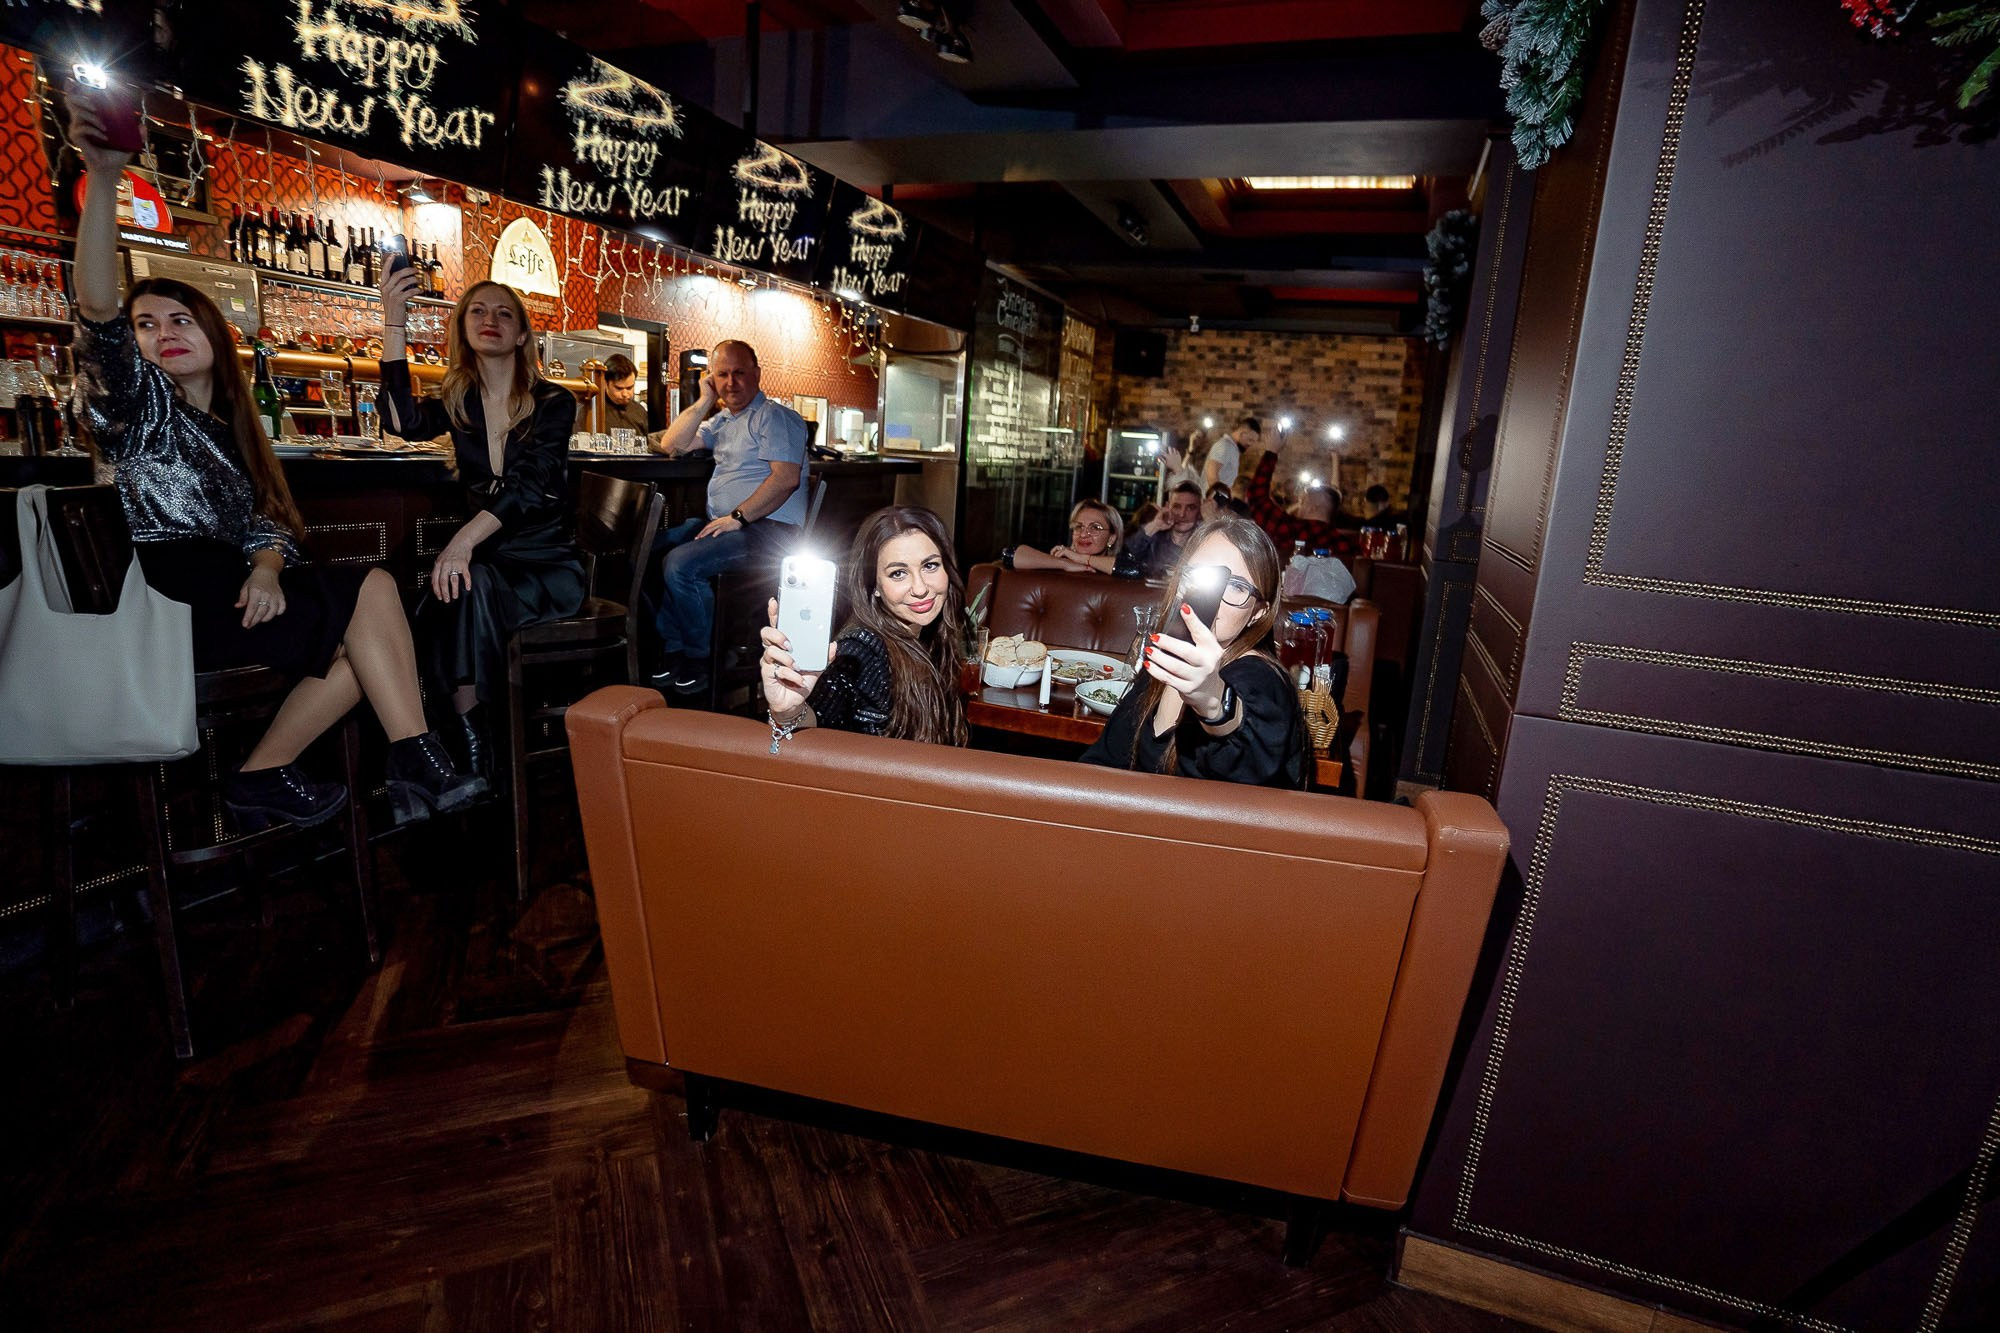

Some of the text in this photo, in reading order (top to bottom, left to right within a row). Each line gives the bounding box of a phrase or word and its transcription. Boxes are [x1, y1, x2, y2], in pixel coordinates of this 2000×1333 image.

[297, 0, 440, 91] Happy
[241, 60, 495, 148] New Year
[574, 119, 659, 179] Happy
[540, 165, 690, 218] New Year
[738, 187, 797, 234] Happy
[508, 243, 545, 275] Leffe
[713, 226, 815, 264] New Year
[851, 235, 893, 271] Happy
[832, 266, 906, 296] New Year
